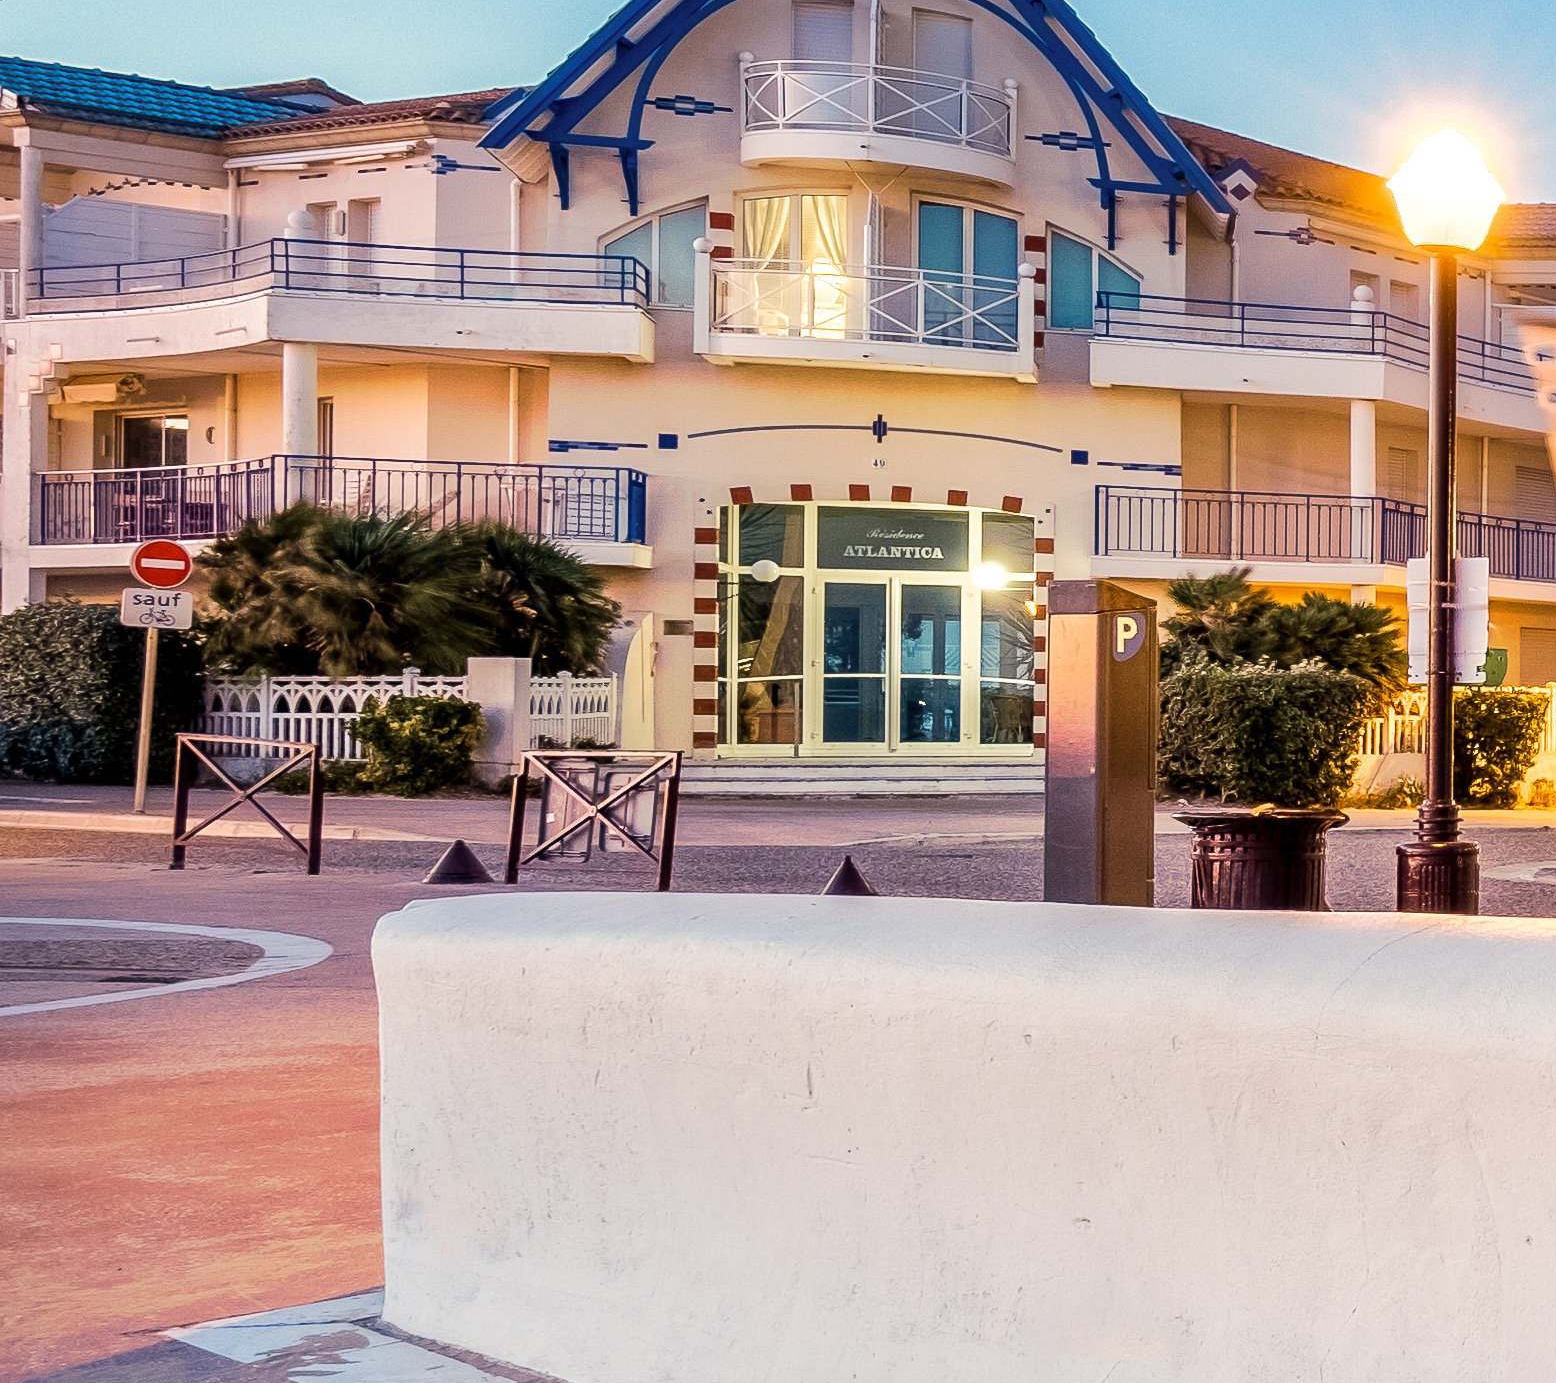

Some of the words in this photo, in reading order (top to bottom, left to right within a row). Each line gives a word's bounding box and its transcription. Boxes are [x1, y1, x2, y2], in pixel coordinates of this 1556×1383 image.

[843, 545, 945, 559] ATLANTICA
[133, 592, 181, 607] sauf
[1116, 616, 1138, 653] P
